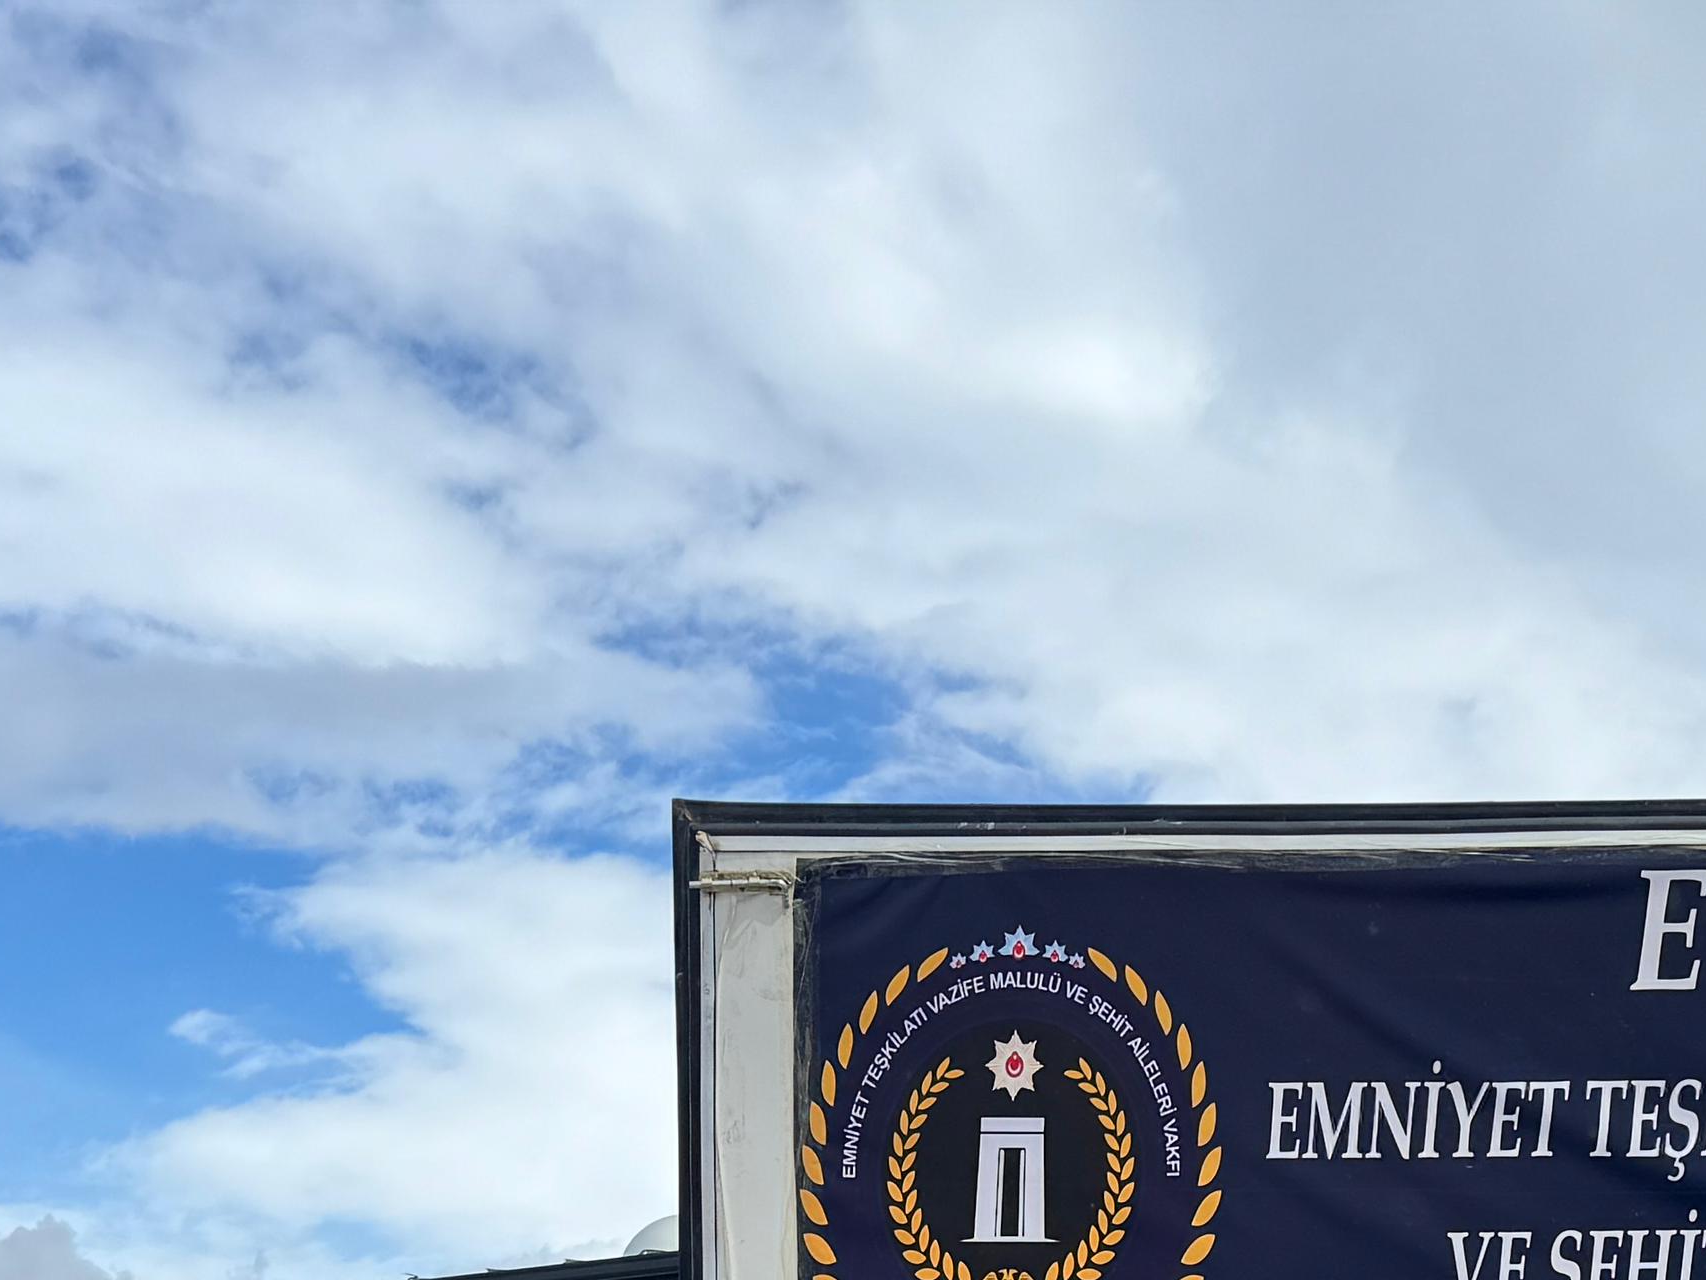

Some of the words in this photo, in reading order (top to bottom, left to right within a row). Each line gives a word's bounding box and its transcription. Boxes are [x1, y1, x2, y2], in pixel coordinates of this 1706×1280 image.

[843, 1091, 870, 1179] EMNİYET
[861, 1006, 929, 1089] TEŞKİLATI
[925, 975, 986, 1014] VAZİFE
[989, 971, 1062, 993] MALULÜ
[1065, 980, 1089, 1005] VE
[1088, 995, 1134, 1038] ŞEHİT
[1127, 1037, 1178, 1117] AİLELERİ
[1162, 1119, 1181, 1177] VAKFI
[1266, 1060, 1571, 1161] EMNİYET
